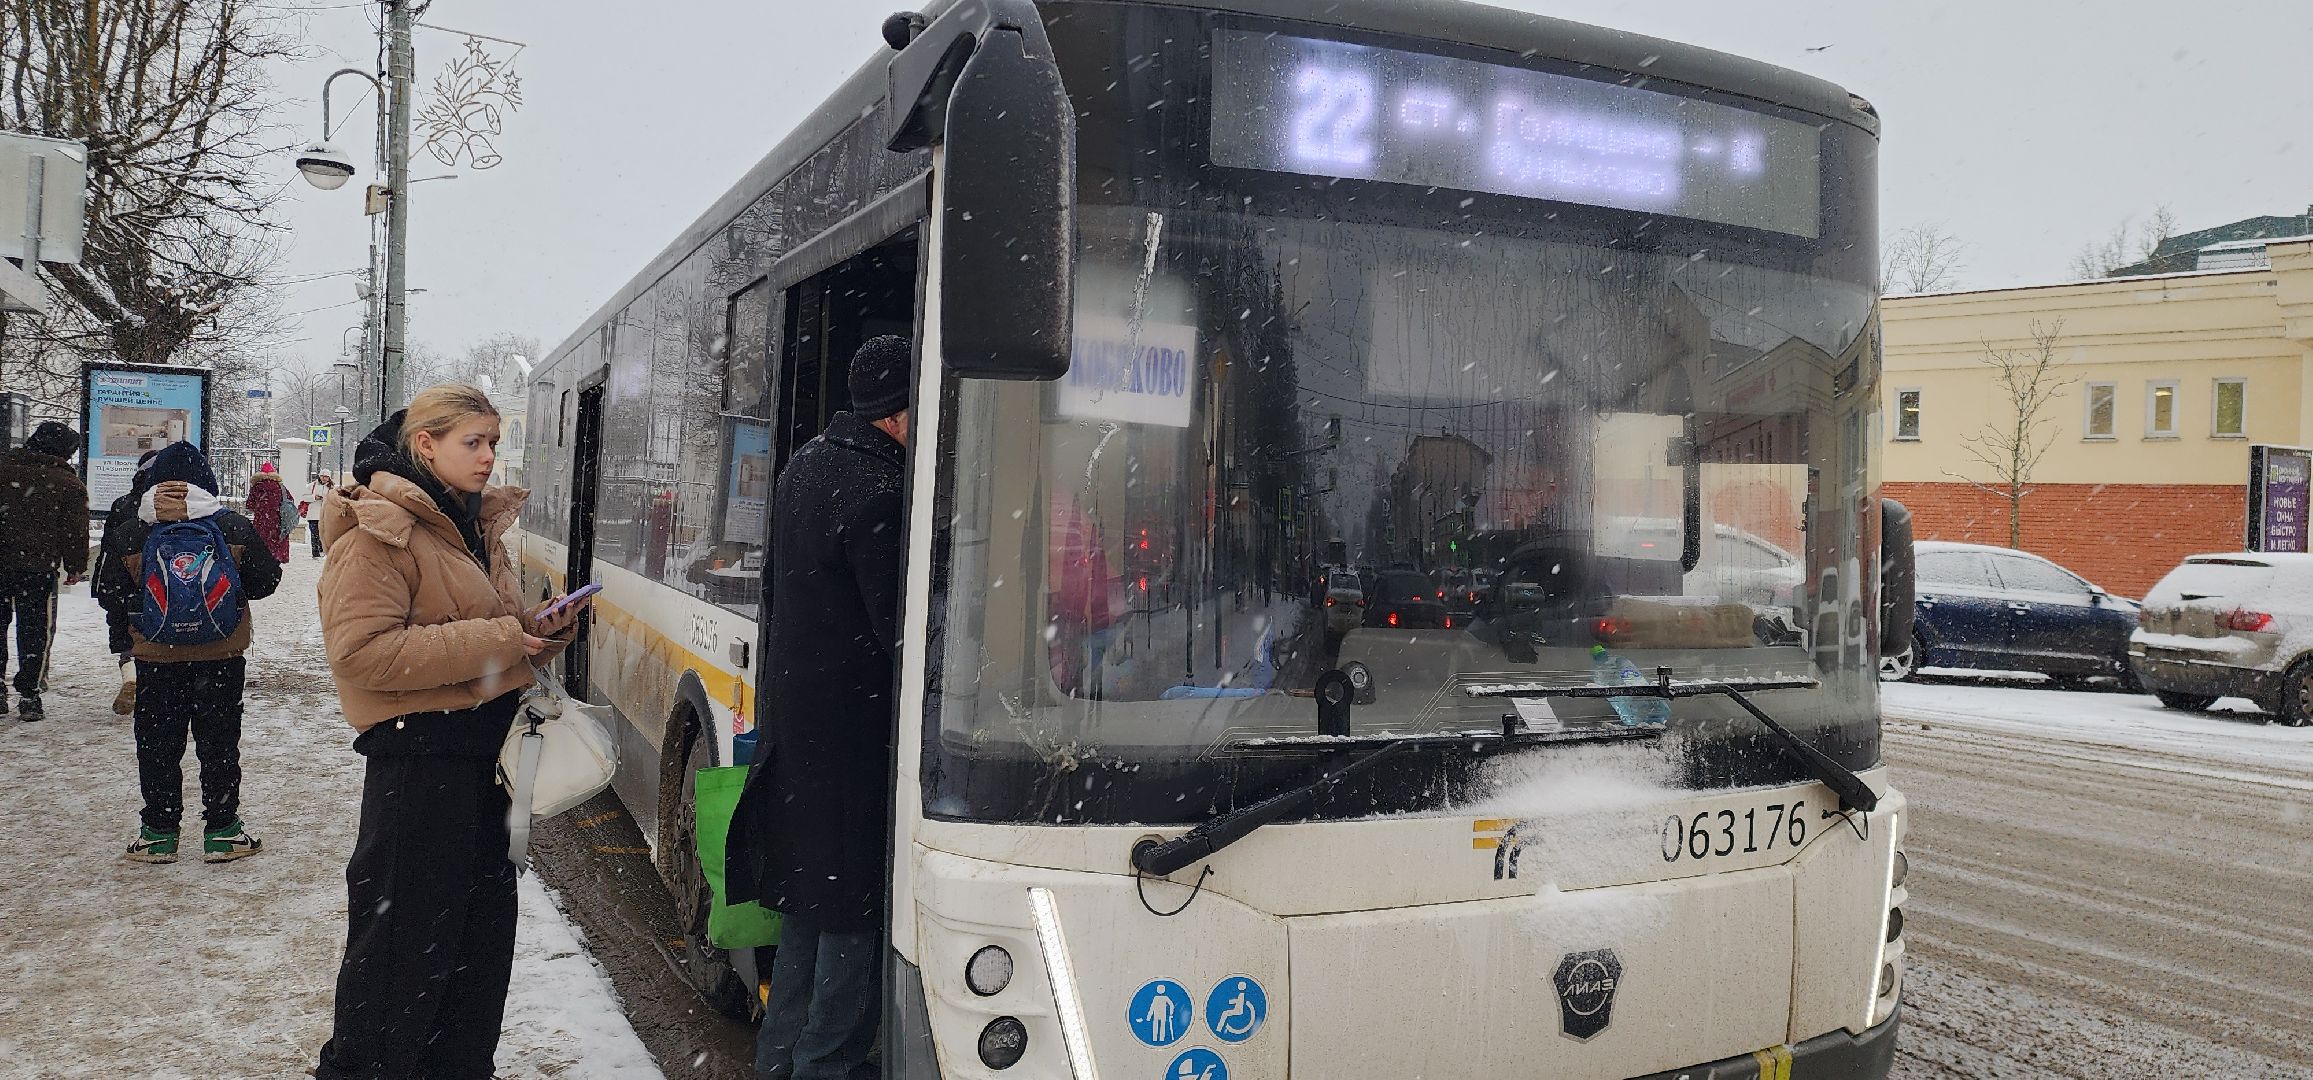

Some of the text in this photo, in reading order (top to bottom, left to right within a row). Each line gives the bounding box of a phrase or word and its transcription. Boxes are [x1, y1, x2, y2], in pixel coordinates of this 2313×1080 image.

[1297, 66, 1369, 164] 22
[2273, 497, 2297, 509] НОВЫЕ
[2276, 511, 2294, 523] ОКНА
[2271, 525, 2297, 537] БЫСТРО
[690, 613, 718, 654] 063176
[1661, 800, 1806, 863] 063176
